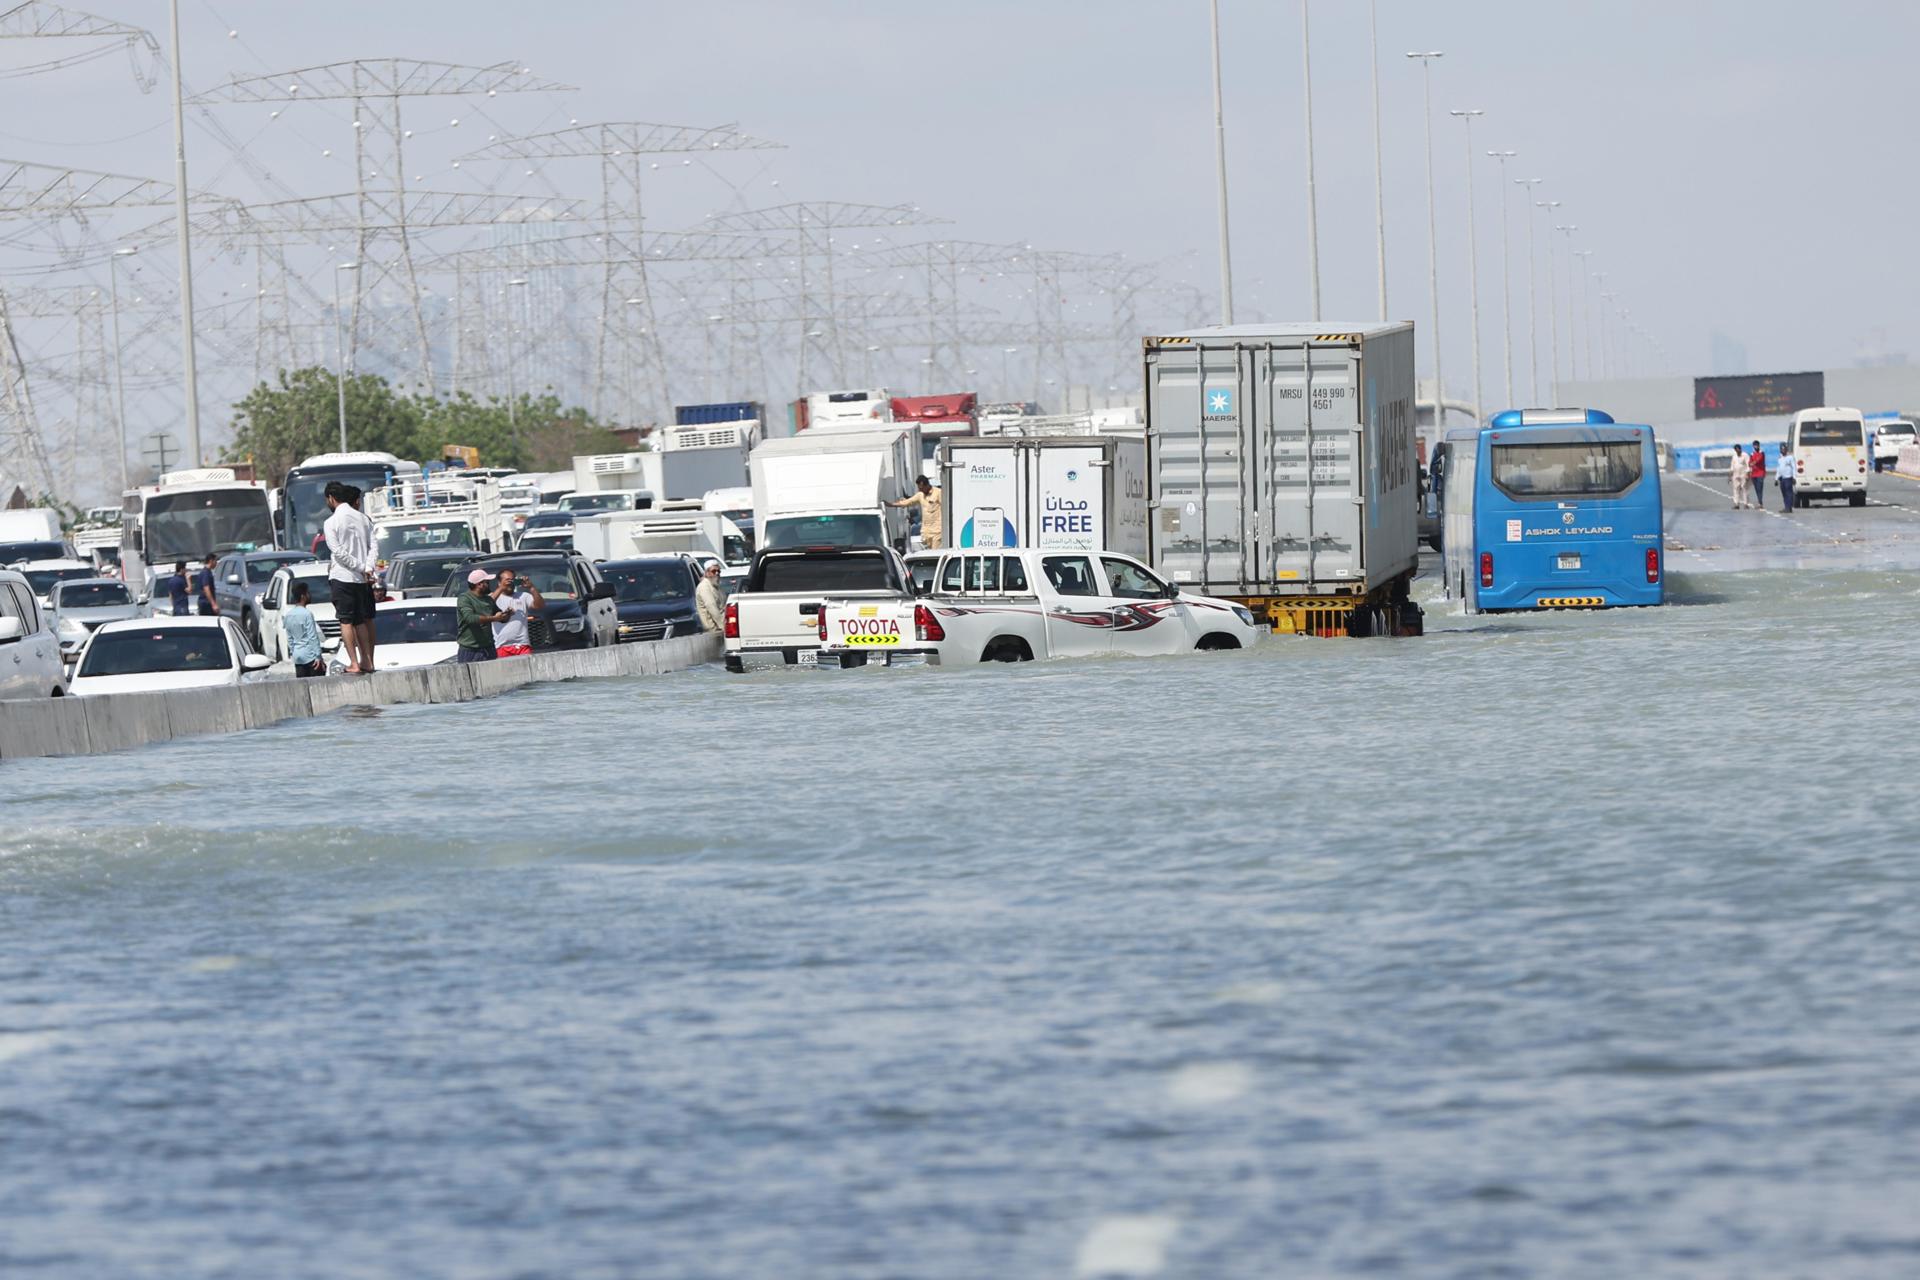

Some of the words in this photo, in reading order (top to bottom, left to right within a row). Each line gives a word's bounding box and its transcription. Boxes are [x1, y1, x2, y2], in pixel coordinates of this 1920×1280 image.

[1279, 388, 1303, 399] MRSU
[1312, 388, 1328, 399] 449
[1329, 388, 1345, 398] 990
[1350, 387, 1356, 399] 7
[1312, 399, 1333, 410] 45G1
[970, 464, 996, 474] Aster
[1042, 515, 1093, 533] FREE
[1524, 528, 1561, 536] ASHOK
[1565, 526, 1613, 535] LEYLAND
[977, 539, 999, 547] Aster
[838, 619, 901, 635] TOYOTA
